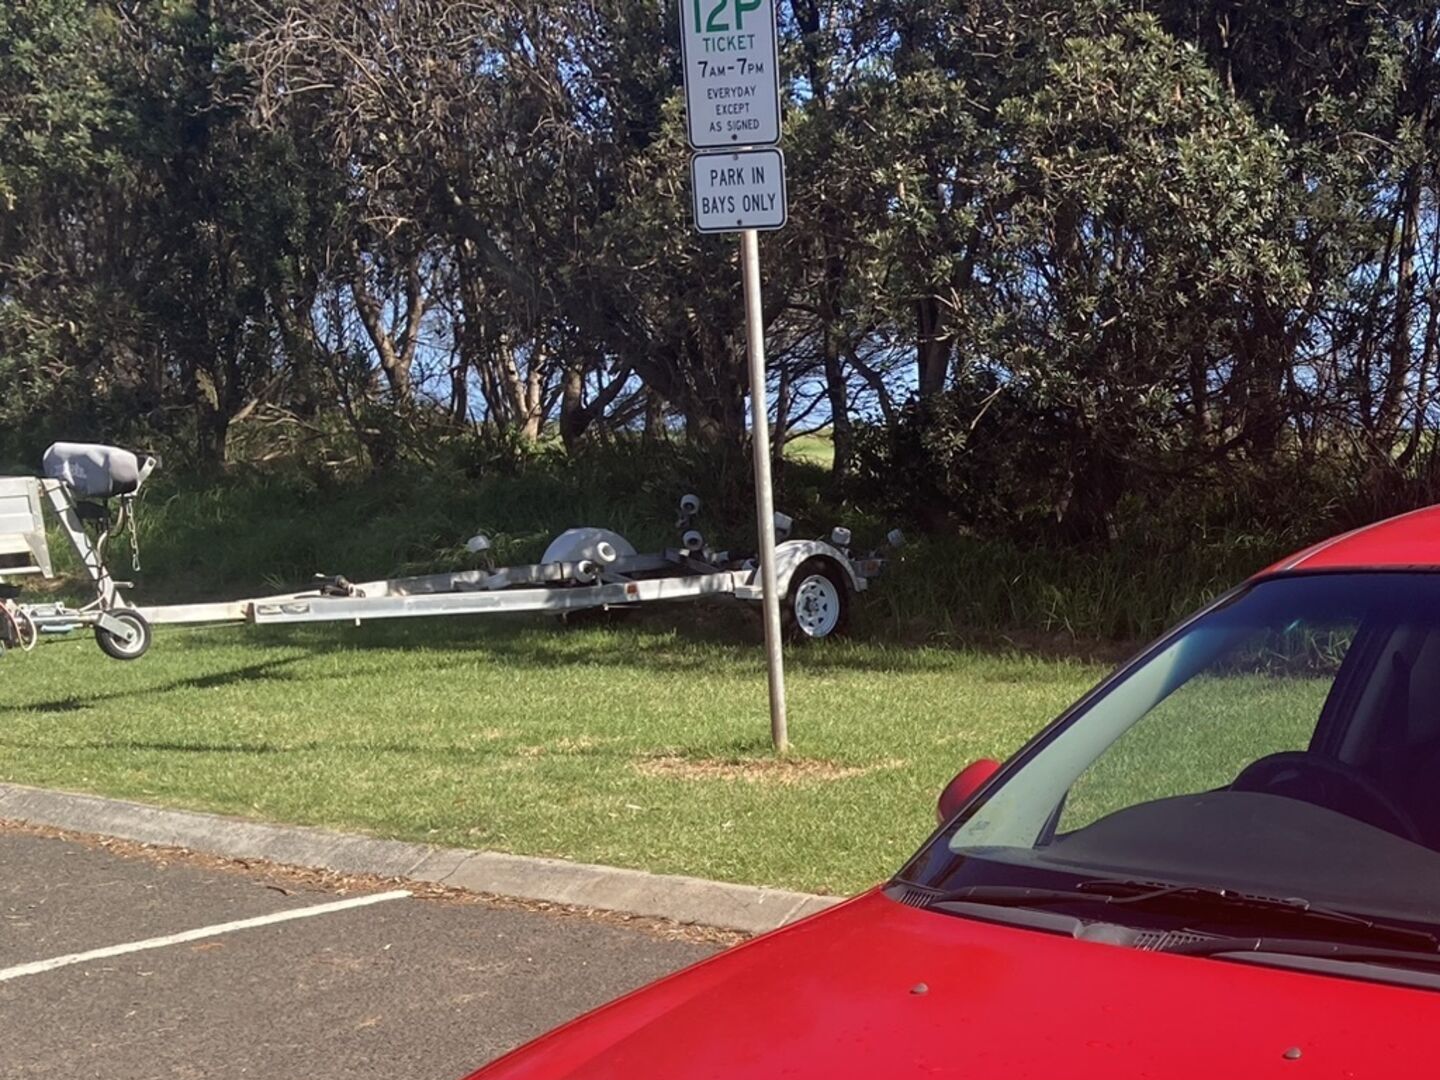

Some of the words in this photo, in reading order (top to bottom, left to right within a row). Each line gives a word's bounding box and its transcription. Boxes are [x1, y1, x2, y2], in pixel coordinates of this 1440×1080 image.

[702, 34, 755, 53] TICKET
[707, 85, 757, 100] EVERYDAY
[716, 102, 750, 116] EXCEPT
[709, 122, 722, 132] AS
[727, 119, 760, 132] SIGNED
[710, 168, 745, 187] PARK
[752, 166, 765, 184] IN
[702, 196, 736, 215] BAYS
[743, 193, 776, 213] ONLY
